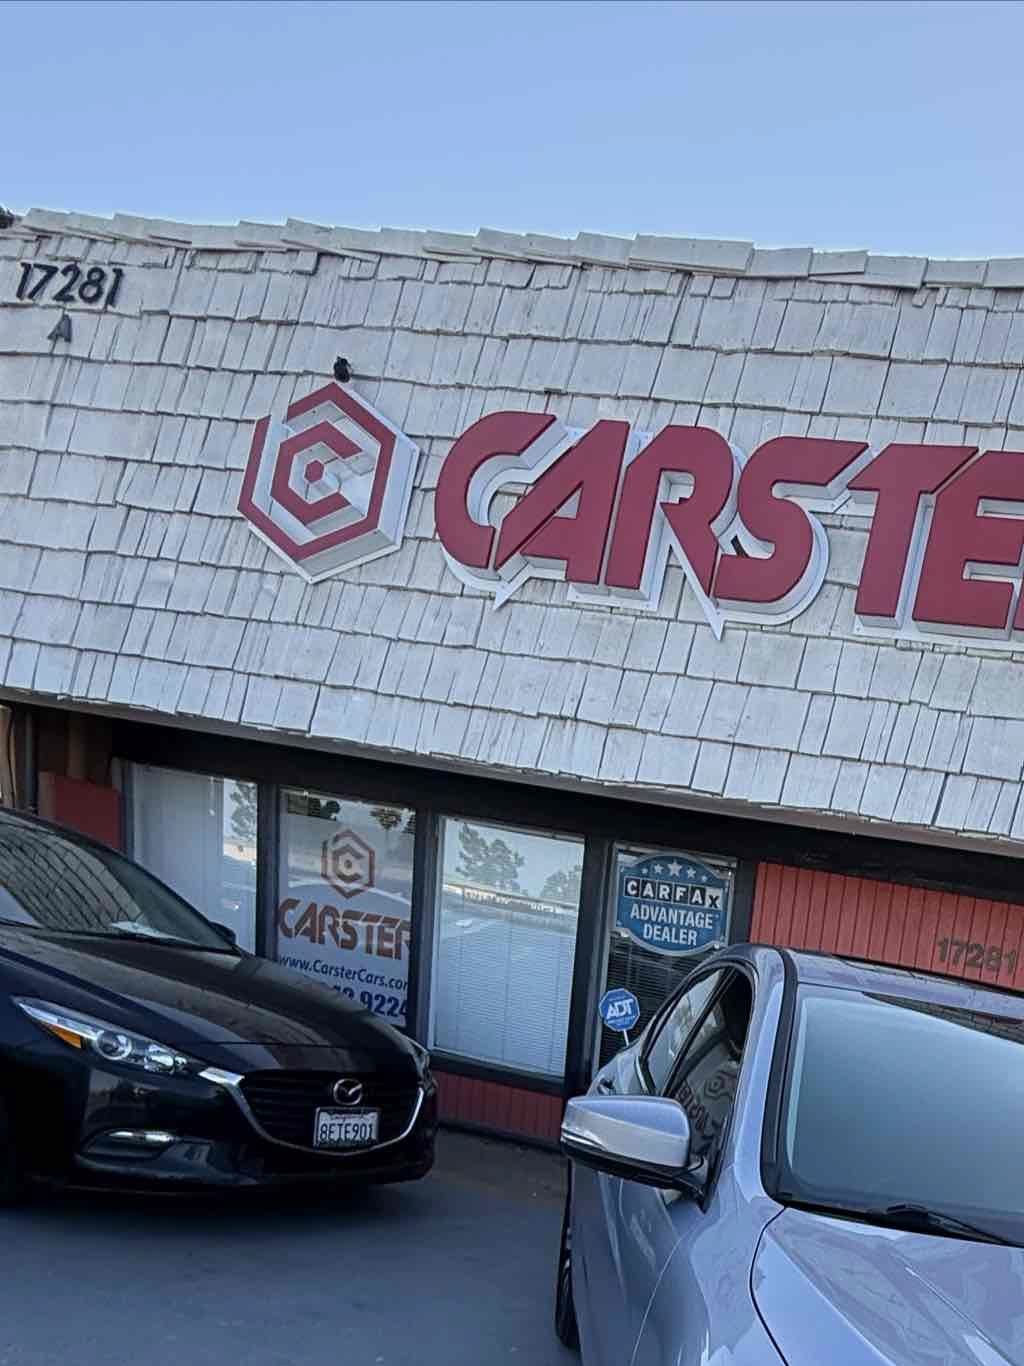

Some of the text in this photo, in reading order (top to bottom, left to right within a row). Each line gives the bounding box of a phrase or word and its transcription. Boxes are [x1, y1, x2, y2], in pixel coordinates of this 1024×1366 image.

[15, 262, 125, 307] 17281
[47, 312, 74, 343] A
[626, 879, 721, 909] CARFAX
[630, 903, 713, 930] ADVANTAGE
[643, 923, 698, 946] DEALER
[937, 937, 1017, 977] 17281
[607, 998, 634, 1019] ADT
